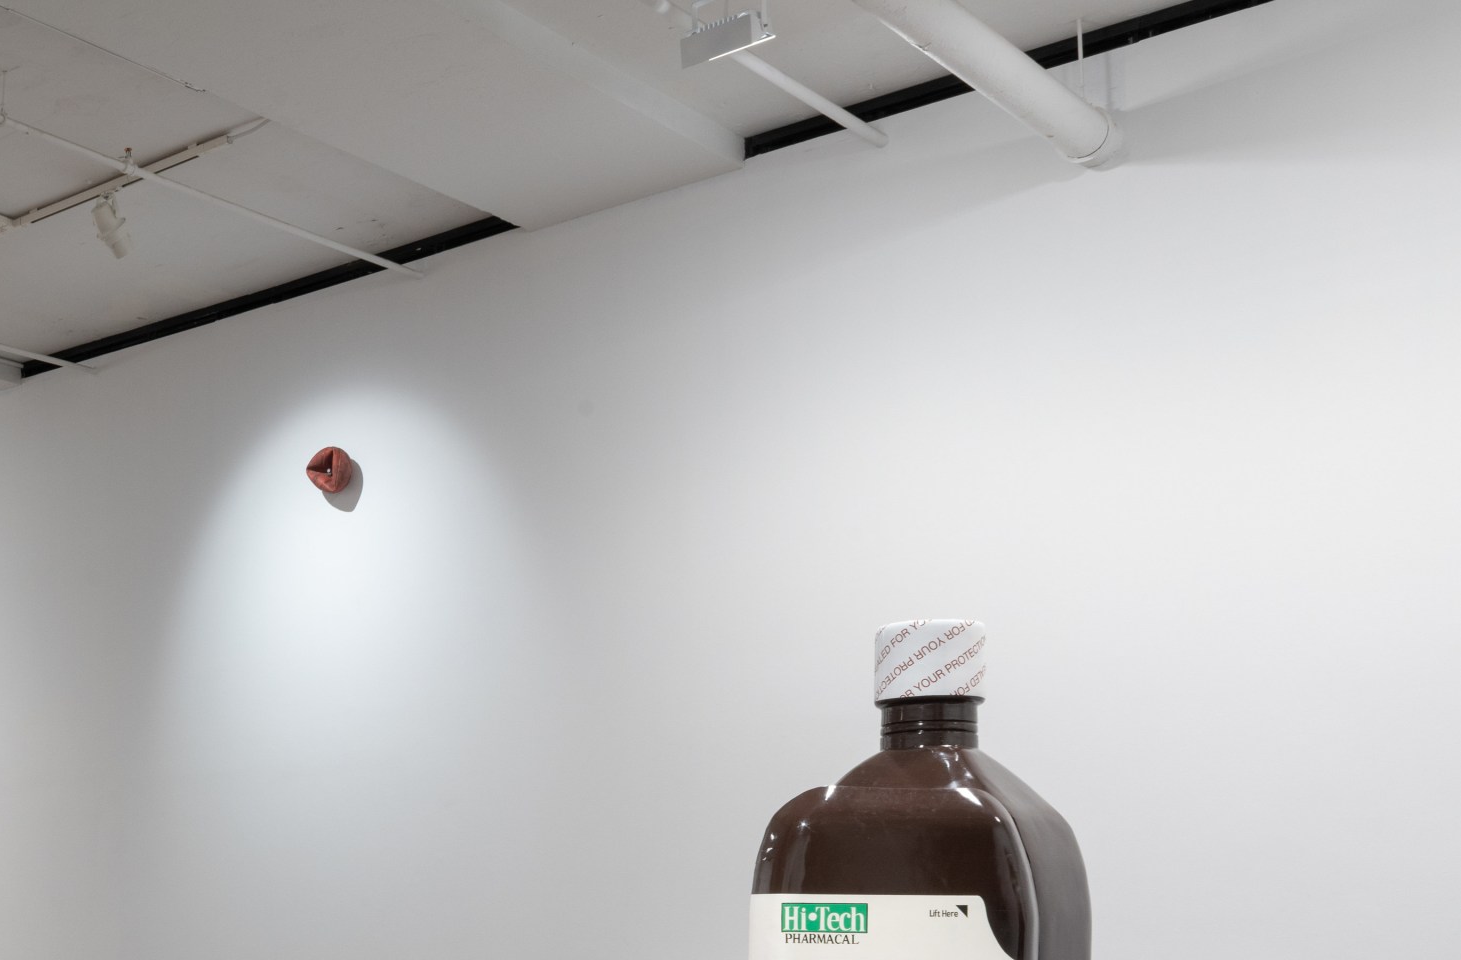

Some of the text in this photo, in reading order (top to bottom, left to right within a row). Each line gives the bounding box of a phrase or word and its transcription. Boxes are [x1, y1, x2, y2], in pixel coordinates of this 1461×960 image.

[890, 628, 911, 647] FOR
[944, 623, 965, 640] FOR
[913, 637, 946, 660] YOUR
[913, 669, 946, 691] YOUR
[785, 934, 859, 944] PHARMACAL
